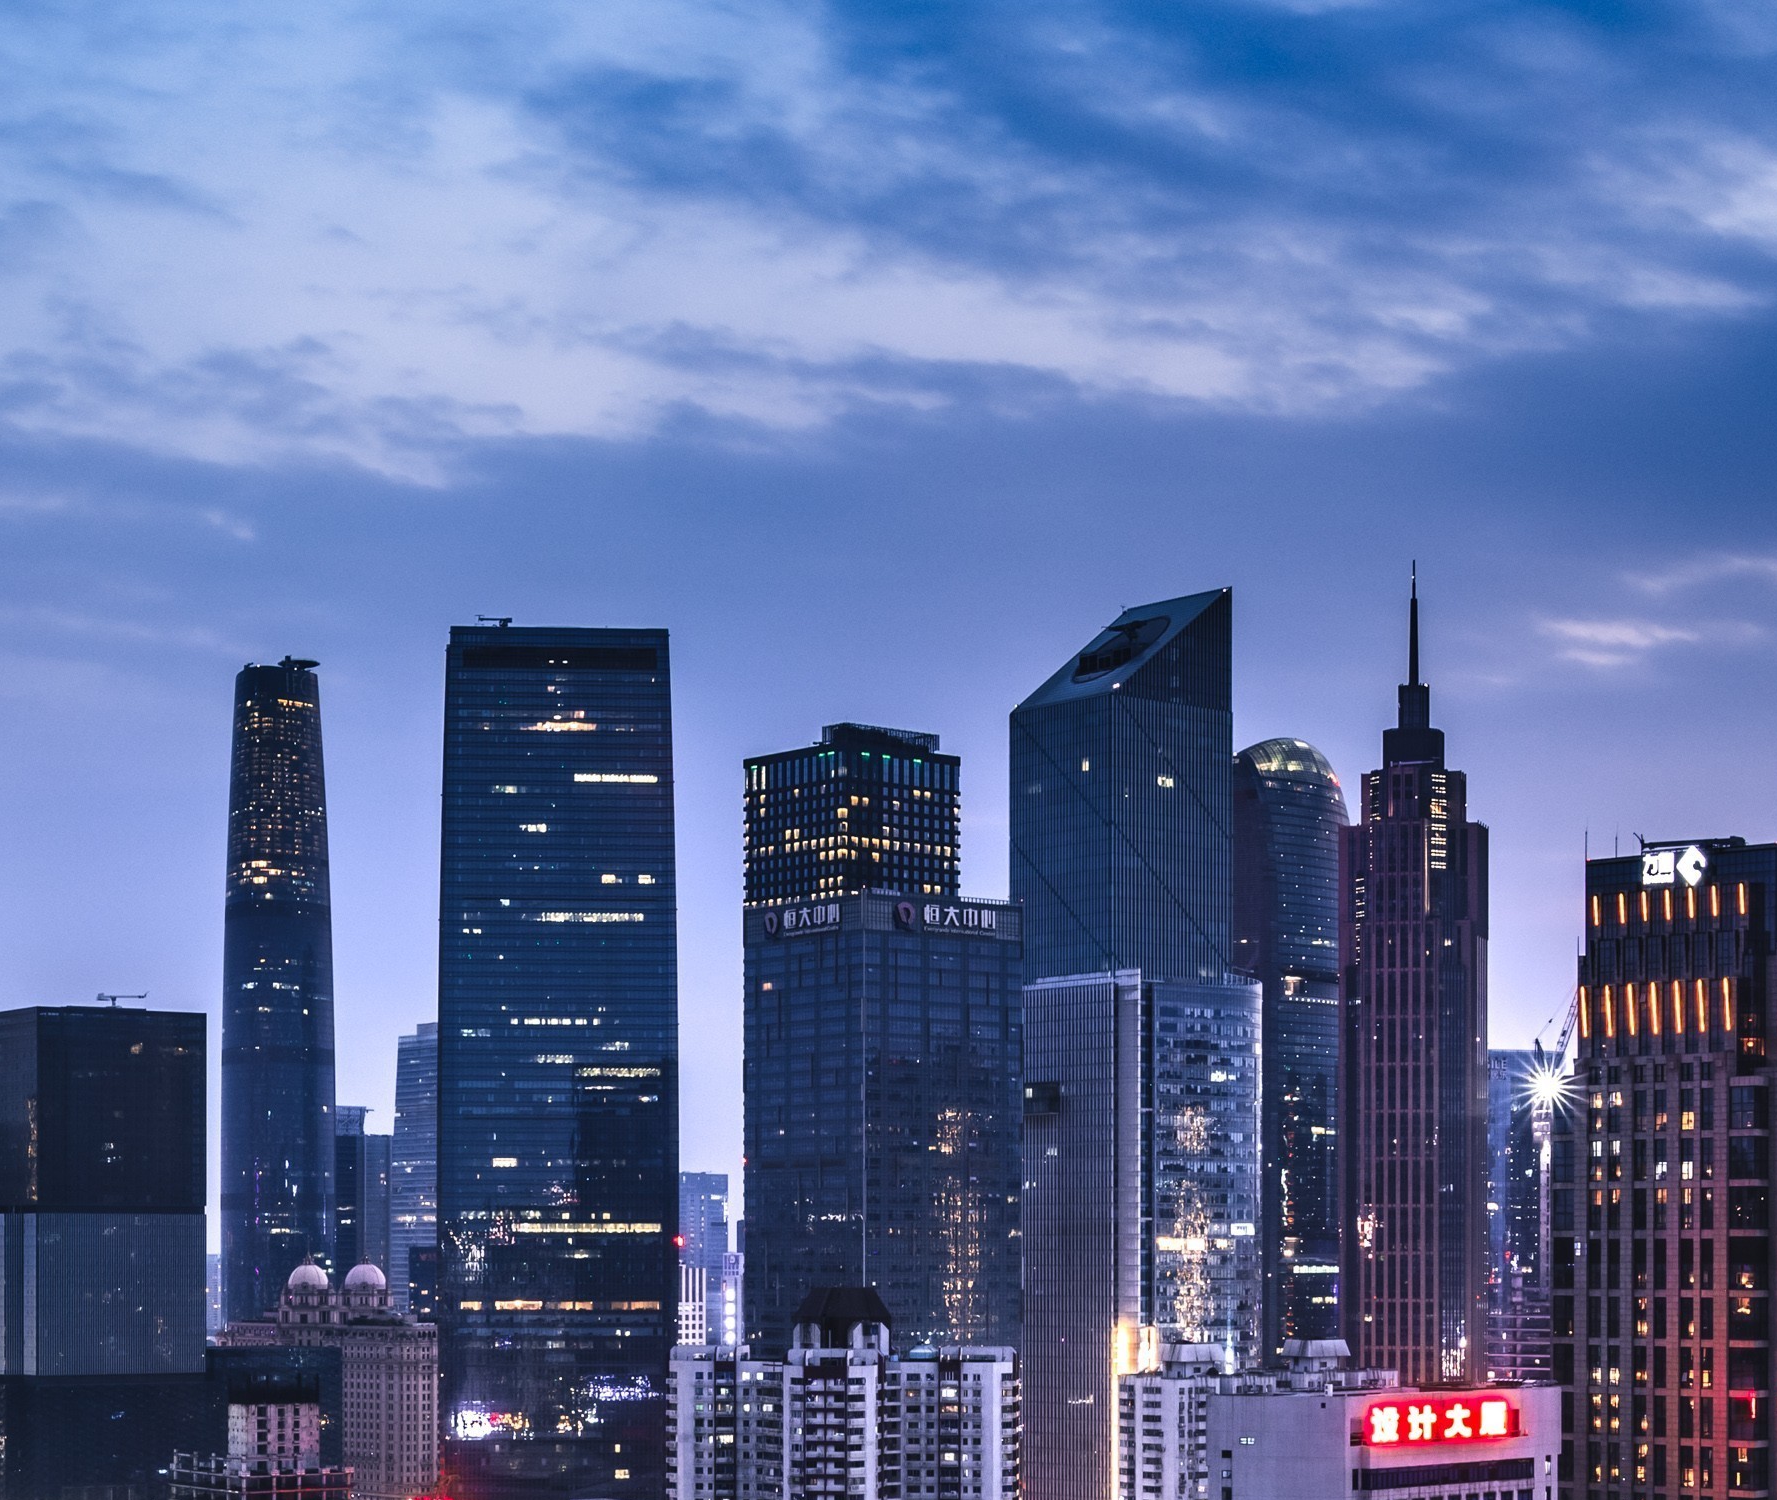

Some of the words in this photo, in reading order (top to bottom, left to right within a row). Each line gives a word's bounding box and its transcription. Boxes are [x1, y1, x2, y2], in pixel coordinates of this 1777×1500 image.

[783, 903, 840, 929] 恒大中心
[924, 904, 996, 929] 恒大中心
